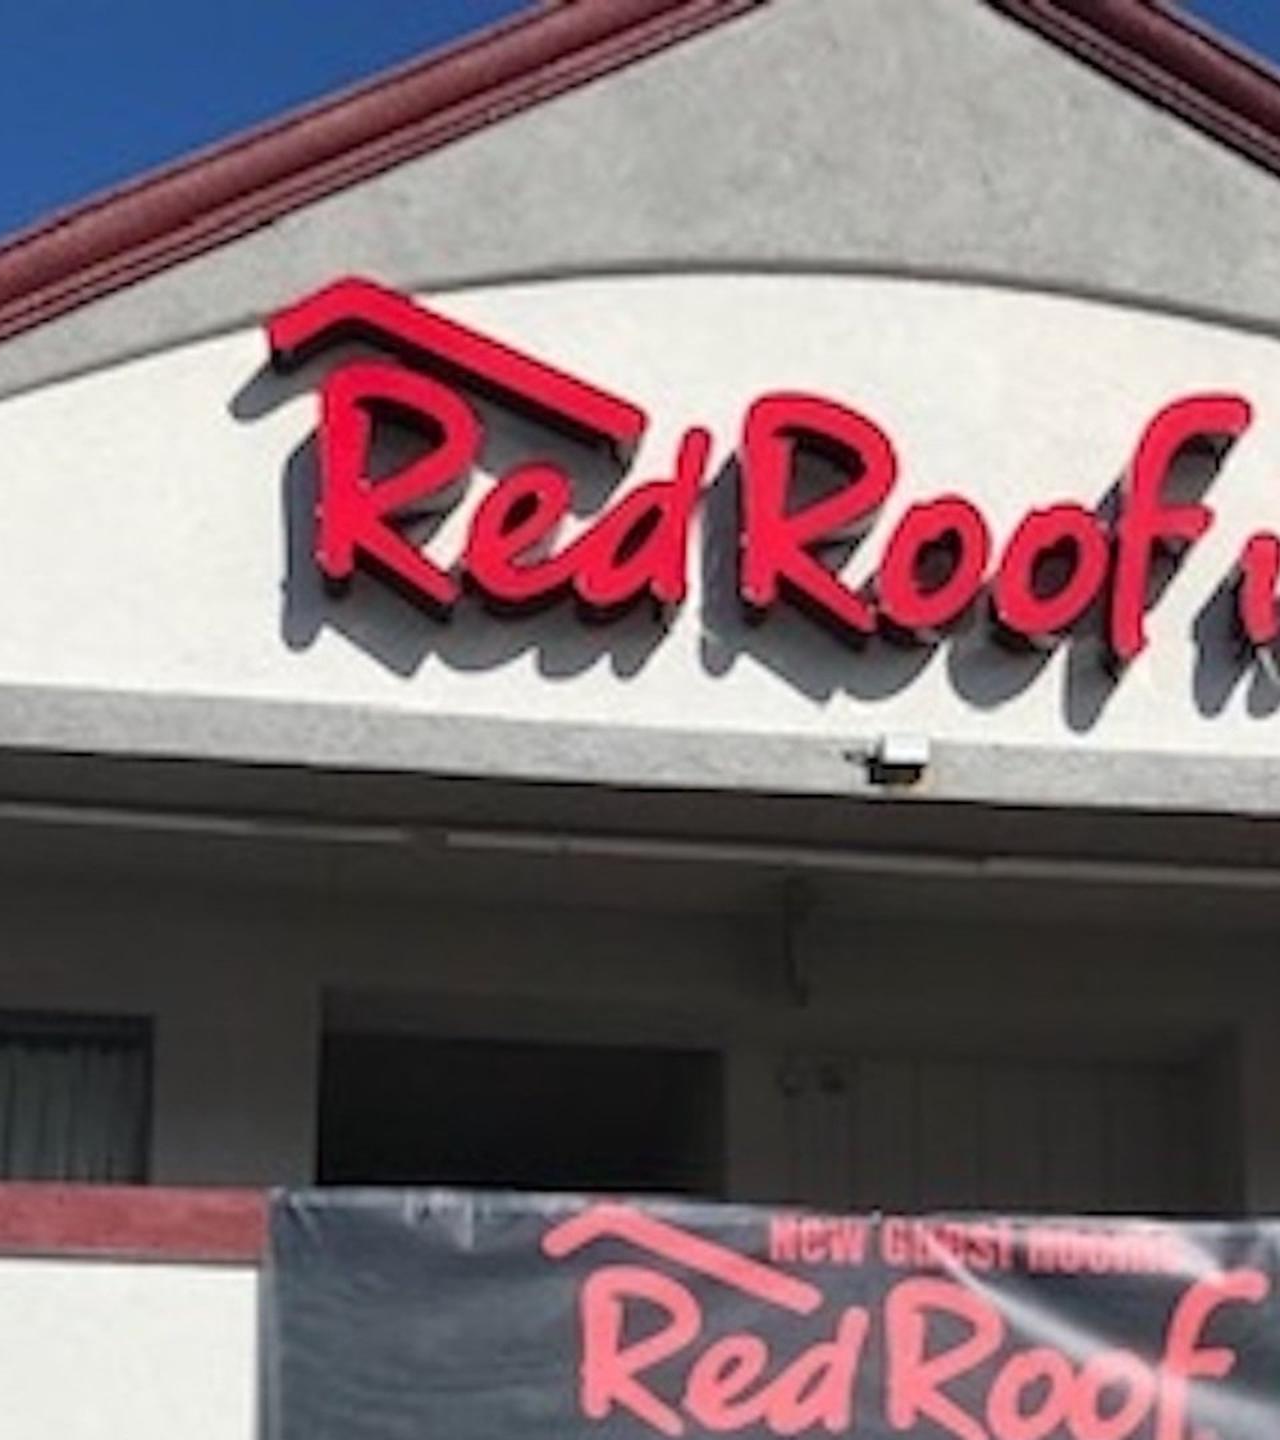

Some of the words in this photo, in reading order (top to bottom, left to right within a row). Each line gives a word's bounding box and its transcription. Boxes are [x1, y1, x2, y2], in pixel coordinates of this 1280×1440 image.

[316, 359, 713, 622] Red
[739, 391, 1253, 660] Roof
[580, 1267, 869, 1435] Red
